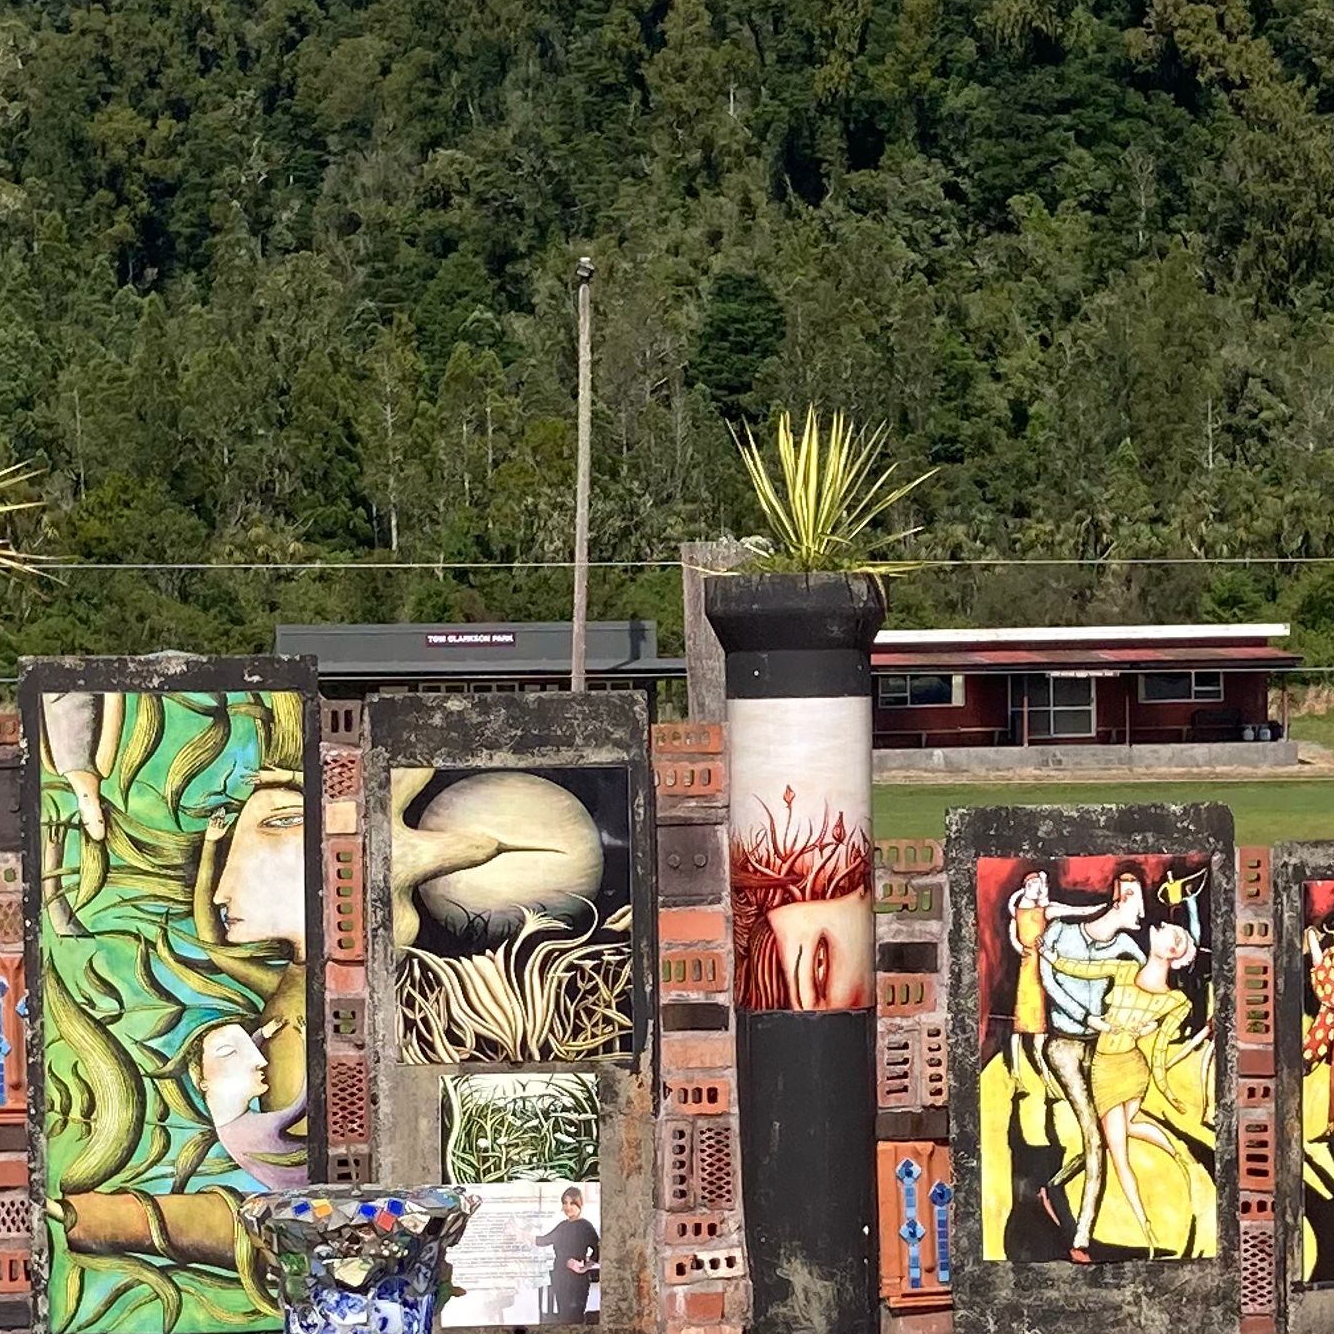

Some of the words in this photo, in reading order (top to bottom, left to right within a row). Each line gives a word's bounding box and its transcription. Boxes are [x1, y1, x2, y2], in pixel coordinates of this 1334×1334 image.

[427, 634, 447, 643] TOM
[447, 634, 491, 643] CLARKSON
[491, 634, 514, 642] PARK
